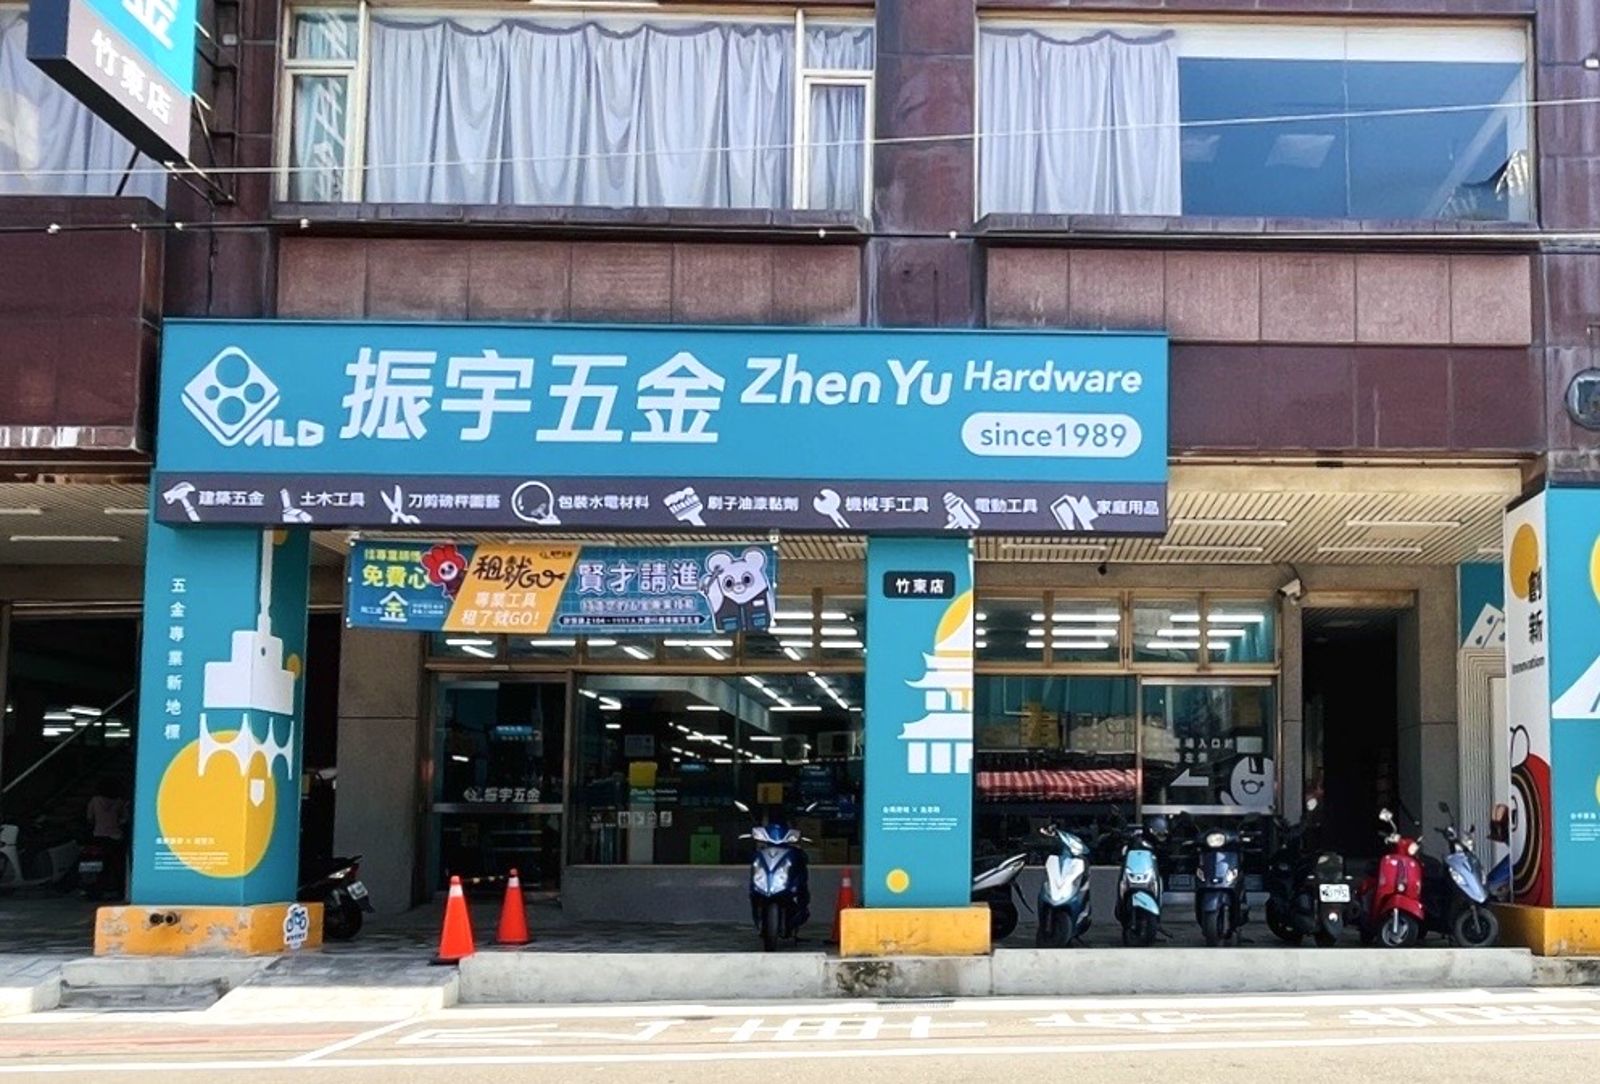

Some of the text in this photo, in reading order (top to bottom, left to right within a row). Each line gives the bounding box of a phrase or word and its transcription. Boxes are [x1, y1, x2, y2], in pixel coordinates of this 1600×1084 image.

[92, 29, 171, 124] 竹東店
[964, 359, 1142, 394] Hardware
[340, 347, 726, 445] 振宇五金
[198, 490, 264, 506] 建築五金
[300, 491, 365, 507] 土木工具
[558, 494, 650, 510] 包裝水電材料
[845, 496, 929, 513] 機械手工具
[974, 497, 1038, 513] 電動工具
[1096, 499, 1159, 515] 家庭用品
[578, 561, 699, 593] 賢才請進
[895, 577, 944, 594] 竹東店
[163, 577, 187, 741] 五金專業新地標
